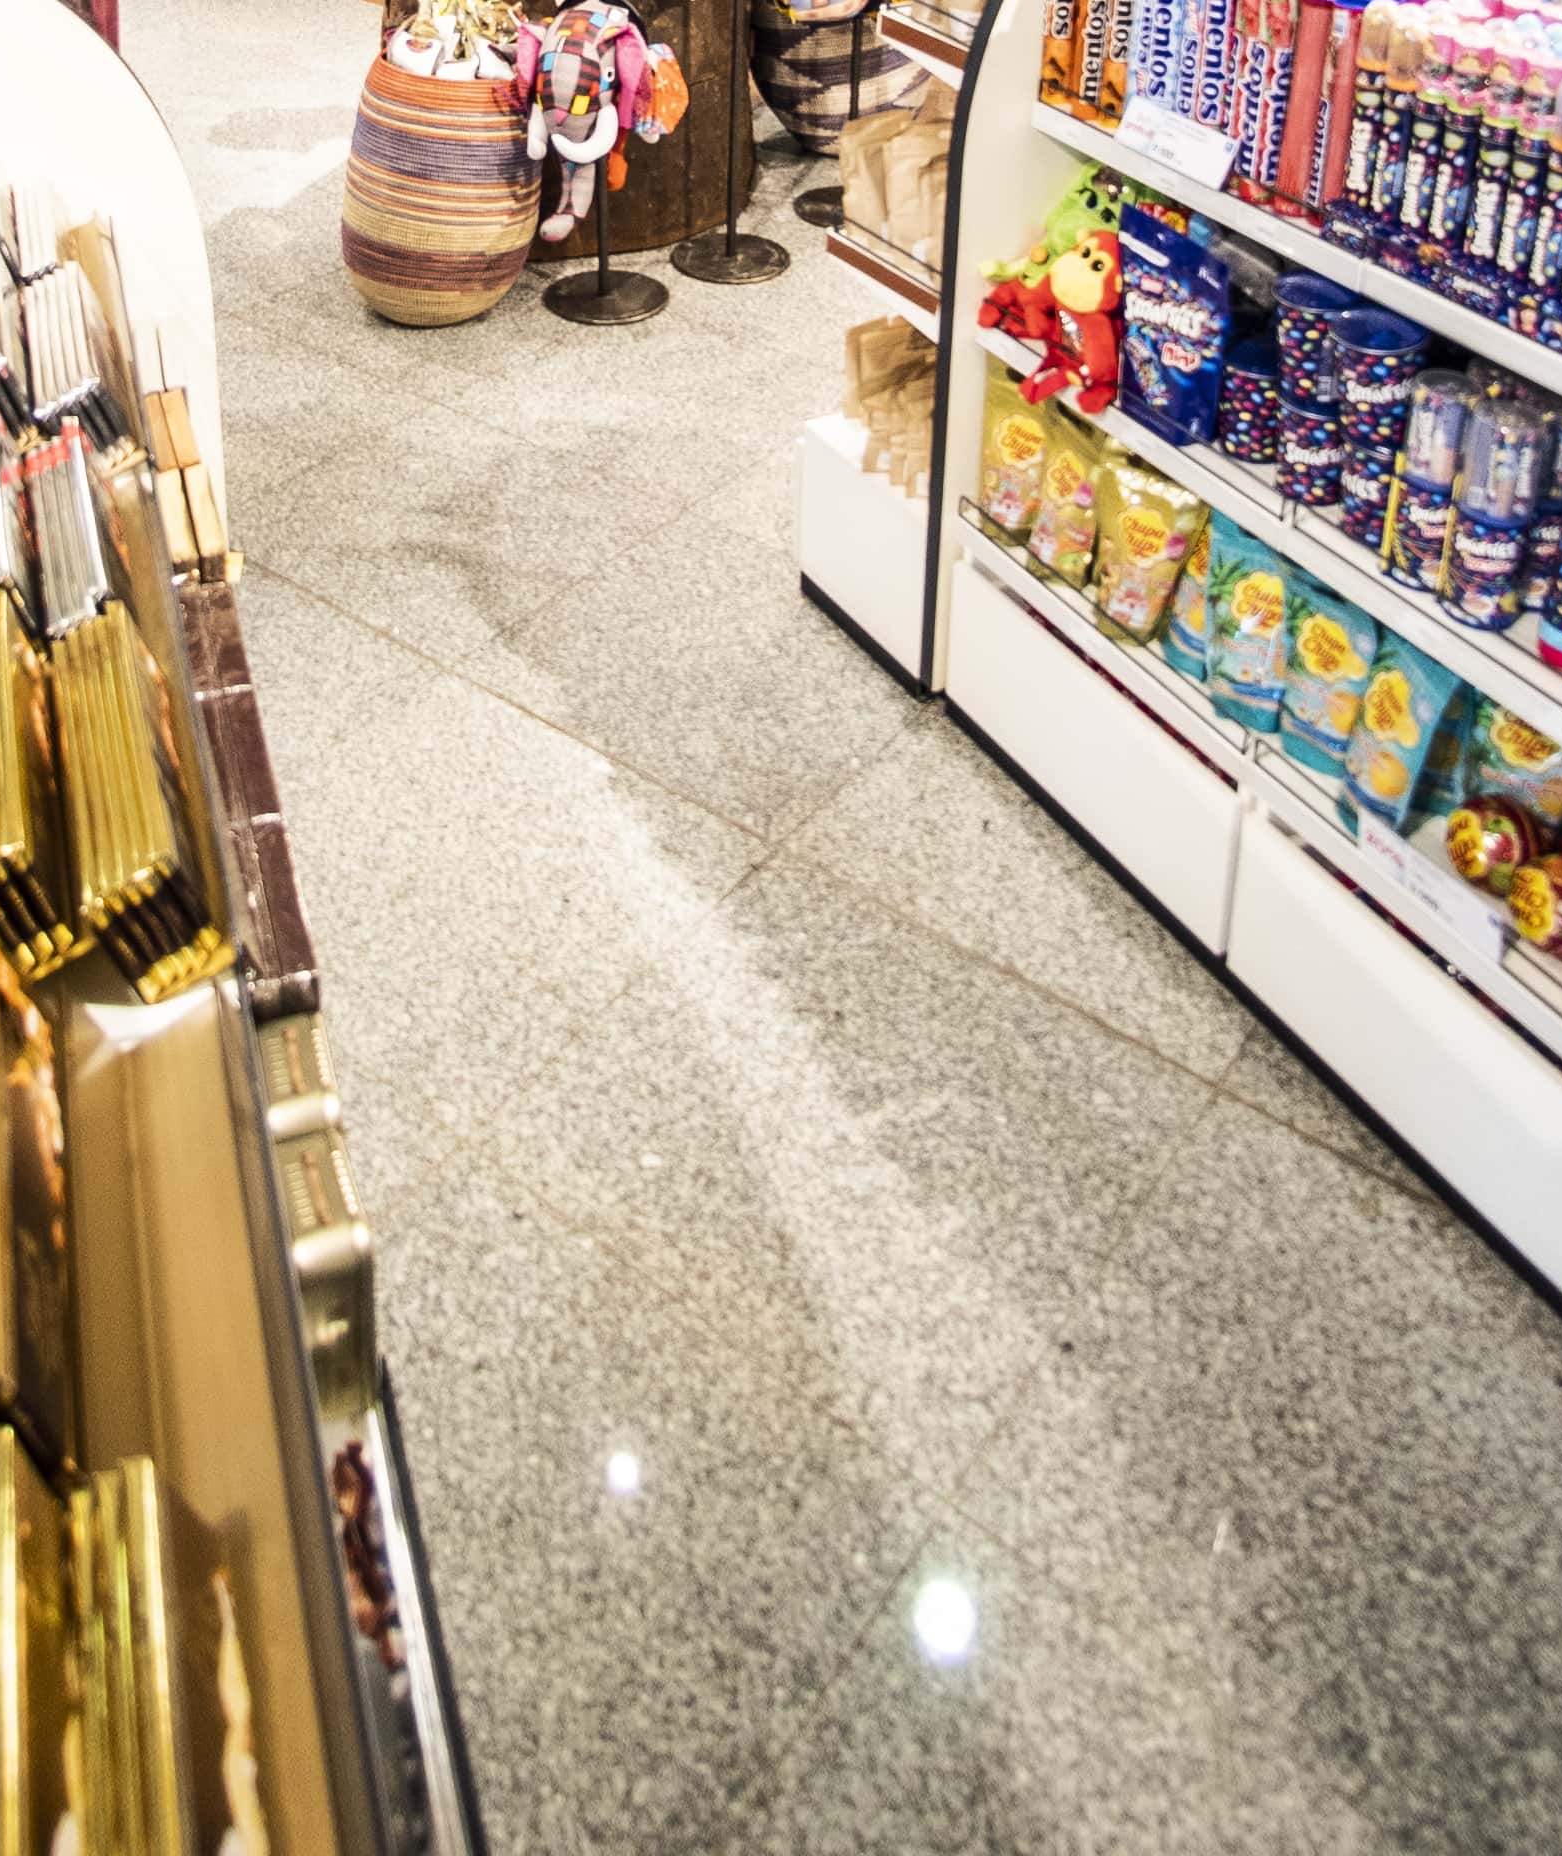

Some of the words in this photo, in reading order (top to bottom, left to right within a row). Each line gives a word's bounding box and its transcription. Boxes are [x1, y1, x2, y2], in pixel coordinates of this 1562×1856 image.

[1082, 0, 1106, 103] mentos
[1238, 40, 1266, 179] mentos
[1306, 99, 1329, 205] mentos
